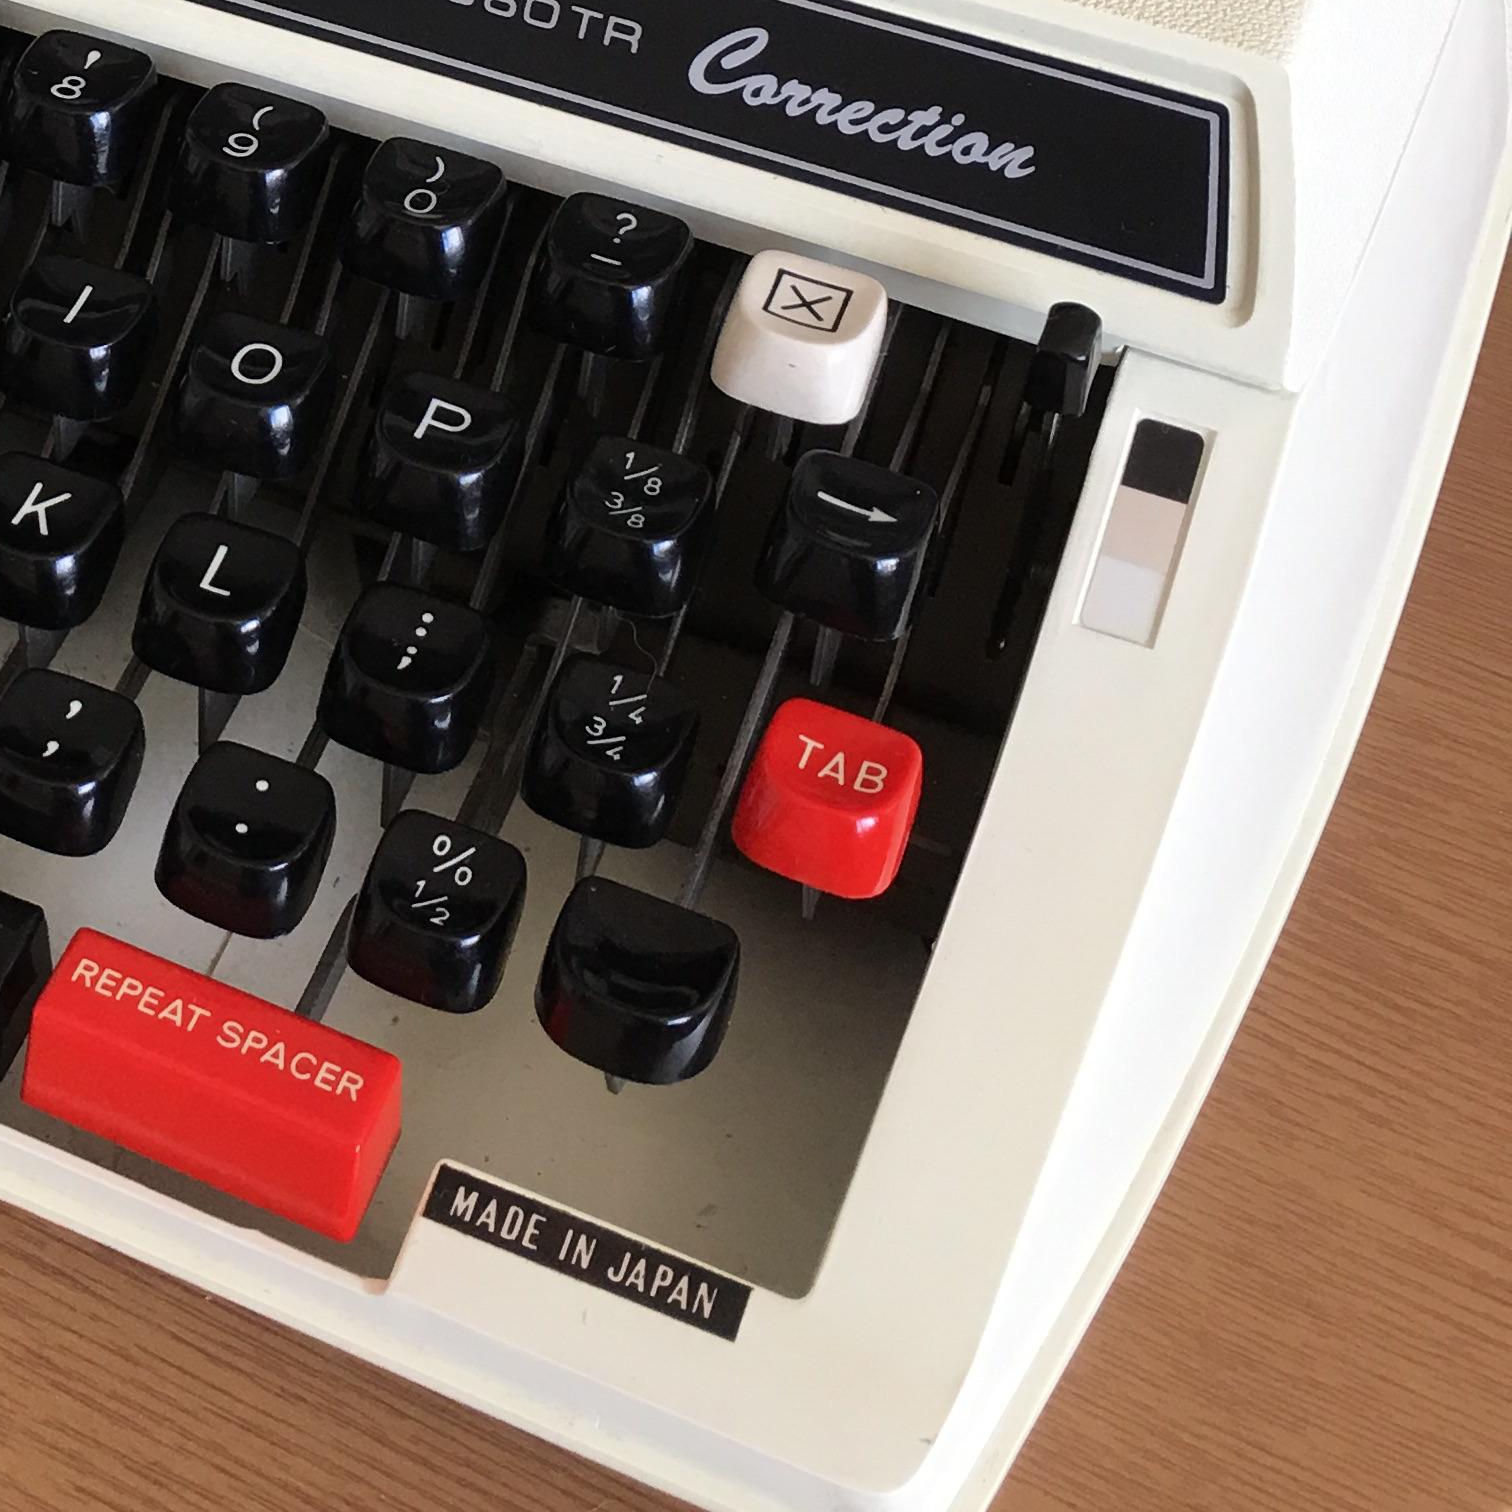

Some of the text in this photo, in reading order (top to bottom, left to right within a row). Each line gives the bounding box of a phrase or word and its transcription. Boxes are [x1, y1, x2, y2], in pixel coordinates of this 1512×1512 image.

[50, 75, 87, 100] 8
[688, 27, 1036, 179] Correction
[222, 132, 259, 158] 9
[612, 212, 638, 244] ?
[414, 397, 472, 439] P
[11, 482, 73, 536] K
[199, 544, 231, 596] L
[797, 733, 888, 794] TAB
[432, 835, 477, 886] %
[70, 958, 365, 1101] REPEAT SPACER
[449, 1186, 719, 1320] MADE IN JAPAN
